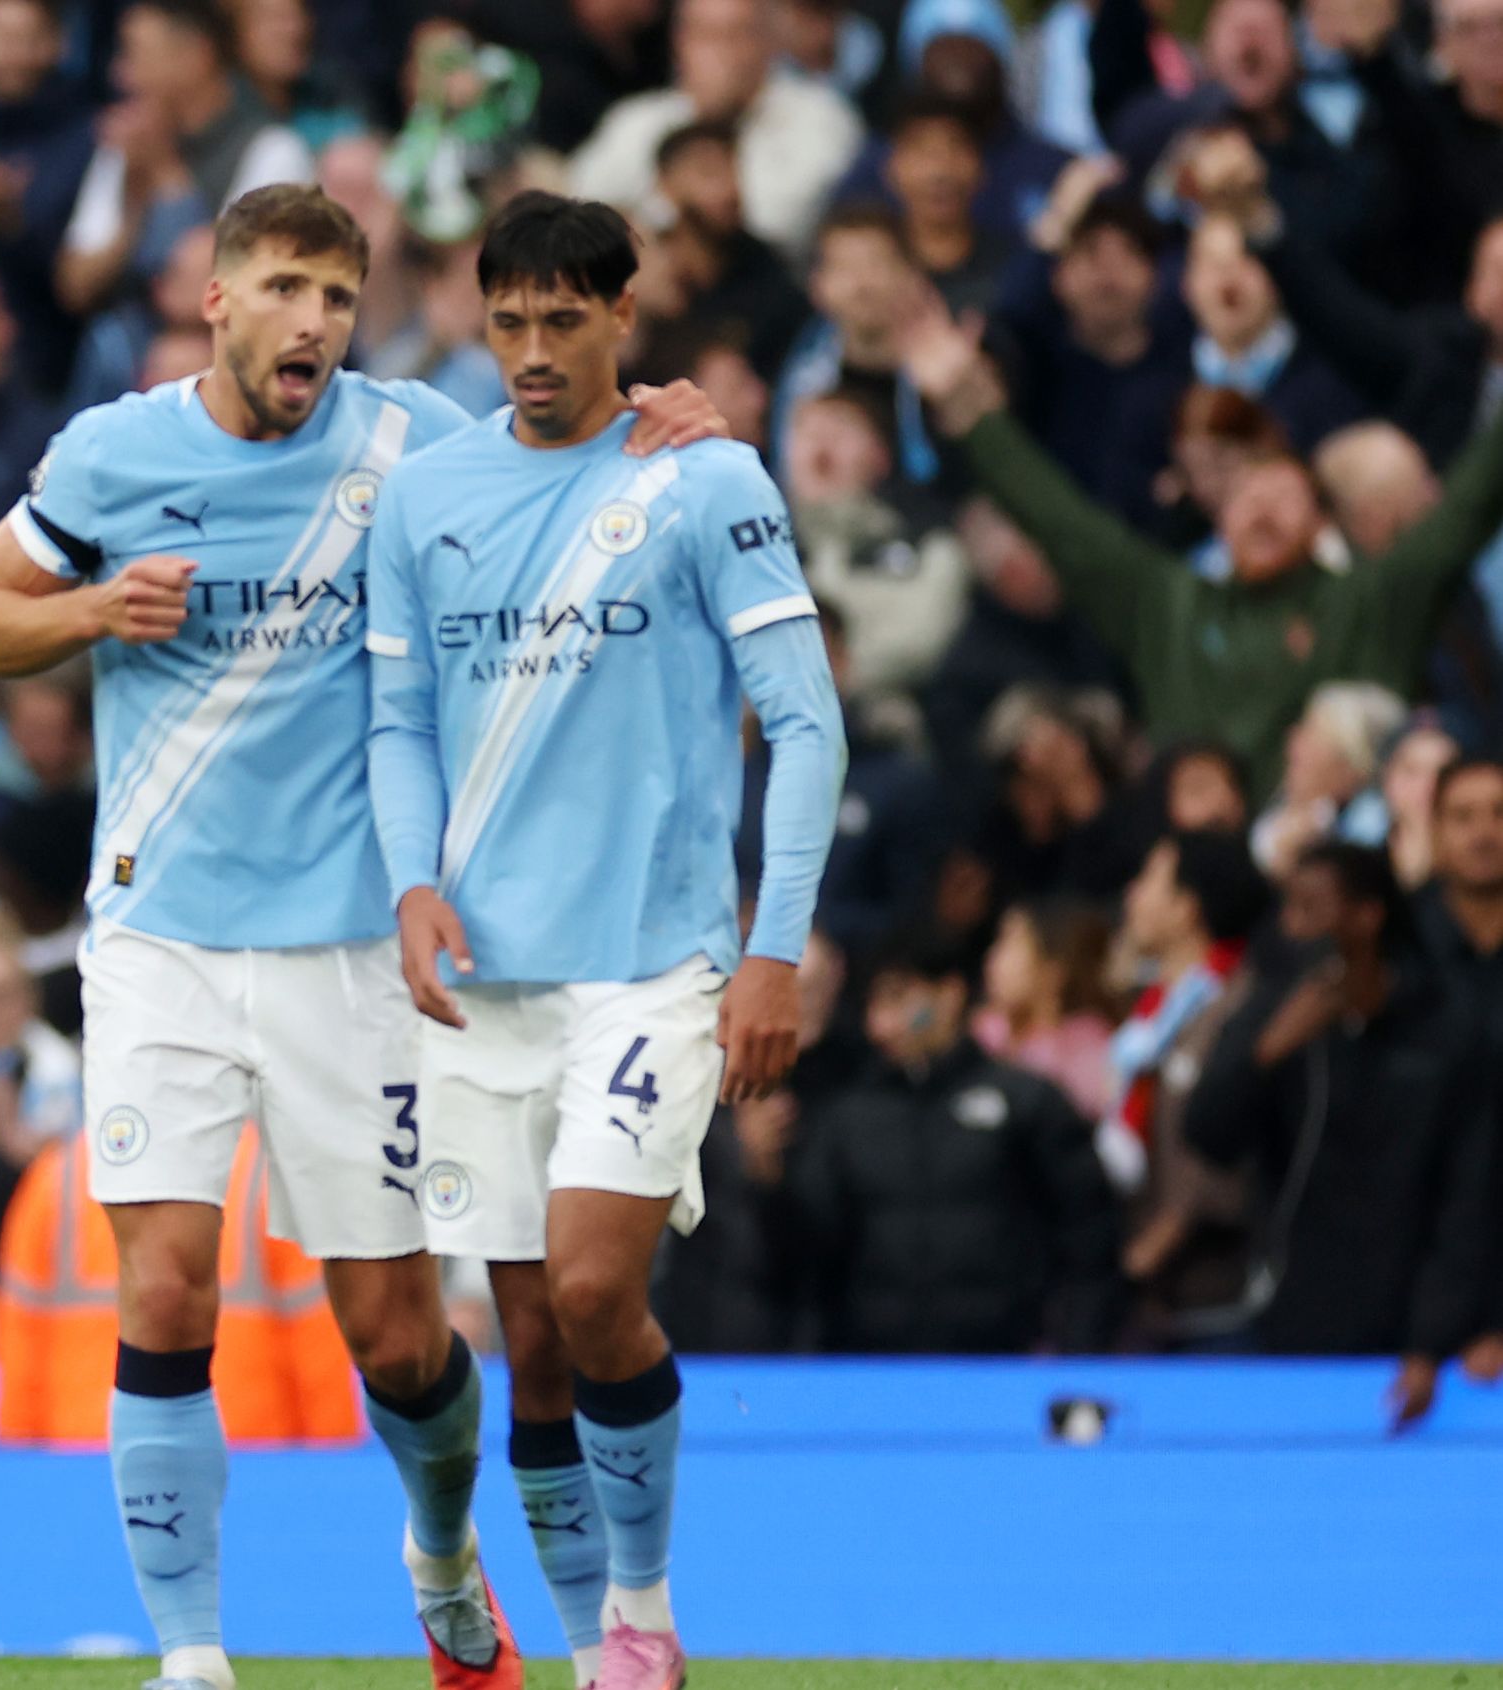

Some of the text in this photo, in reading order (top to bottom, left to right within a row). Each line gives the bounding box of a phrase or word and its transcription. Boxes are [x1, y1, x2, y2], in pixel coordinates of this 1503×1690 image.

[189, 572, 368, 615] TIHA
[204, 620, 352, 651] AIRWAYS
[438, 600, 651, 649] ETIHAD
[608, 1036, 659, 1114] 4
[382, 1083, 418, 1169] 3
